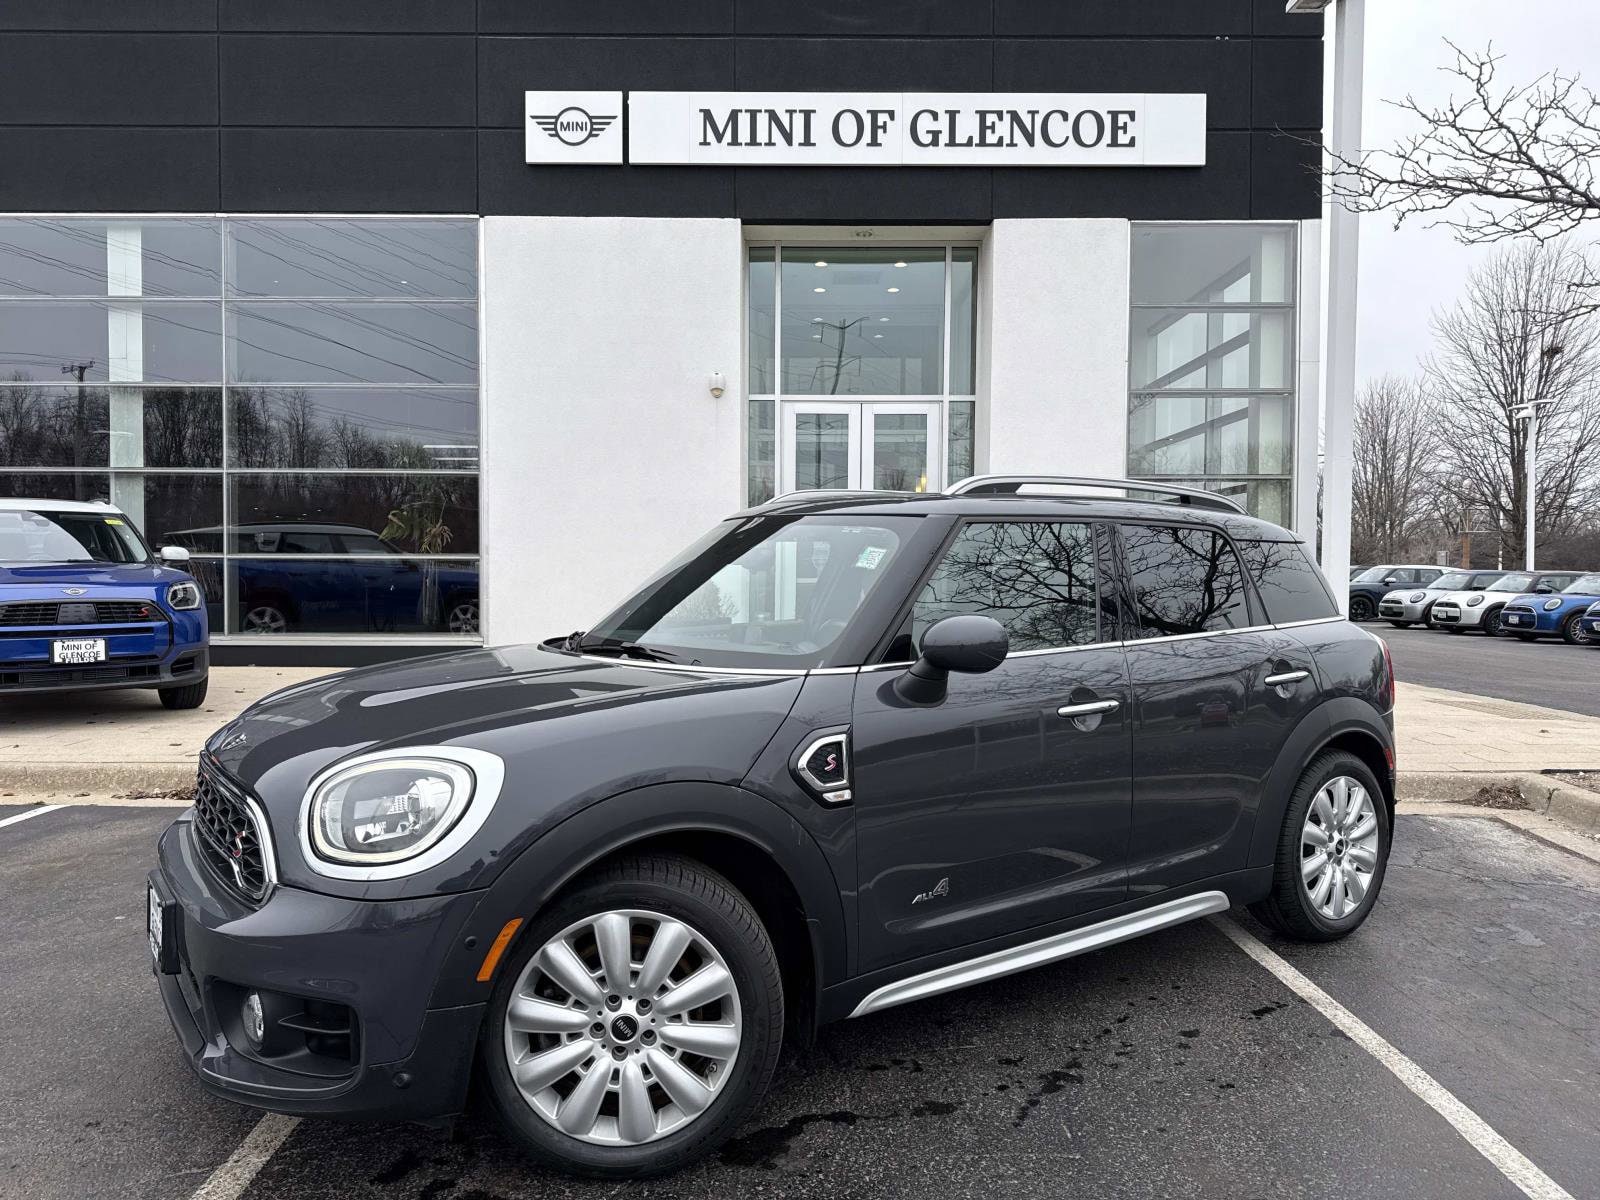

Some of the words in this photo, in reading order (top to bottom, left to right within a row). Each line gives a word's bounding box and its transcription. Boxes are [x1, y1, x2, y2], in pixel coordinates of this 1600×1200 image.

[560, 121, 588, 132] MINI
[699, 108, 817, 147] MINI
[831, 108, 895, 148] OF
[909, 109, 1136, 148] GLENCOE
[58, 651, 101, 659] GLENCOE
[824, 753, 837, 772] S
[616, 1019, 634, 1037] MINI
